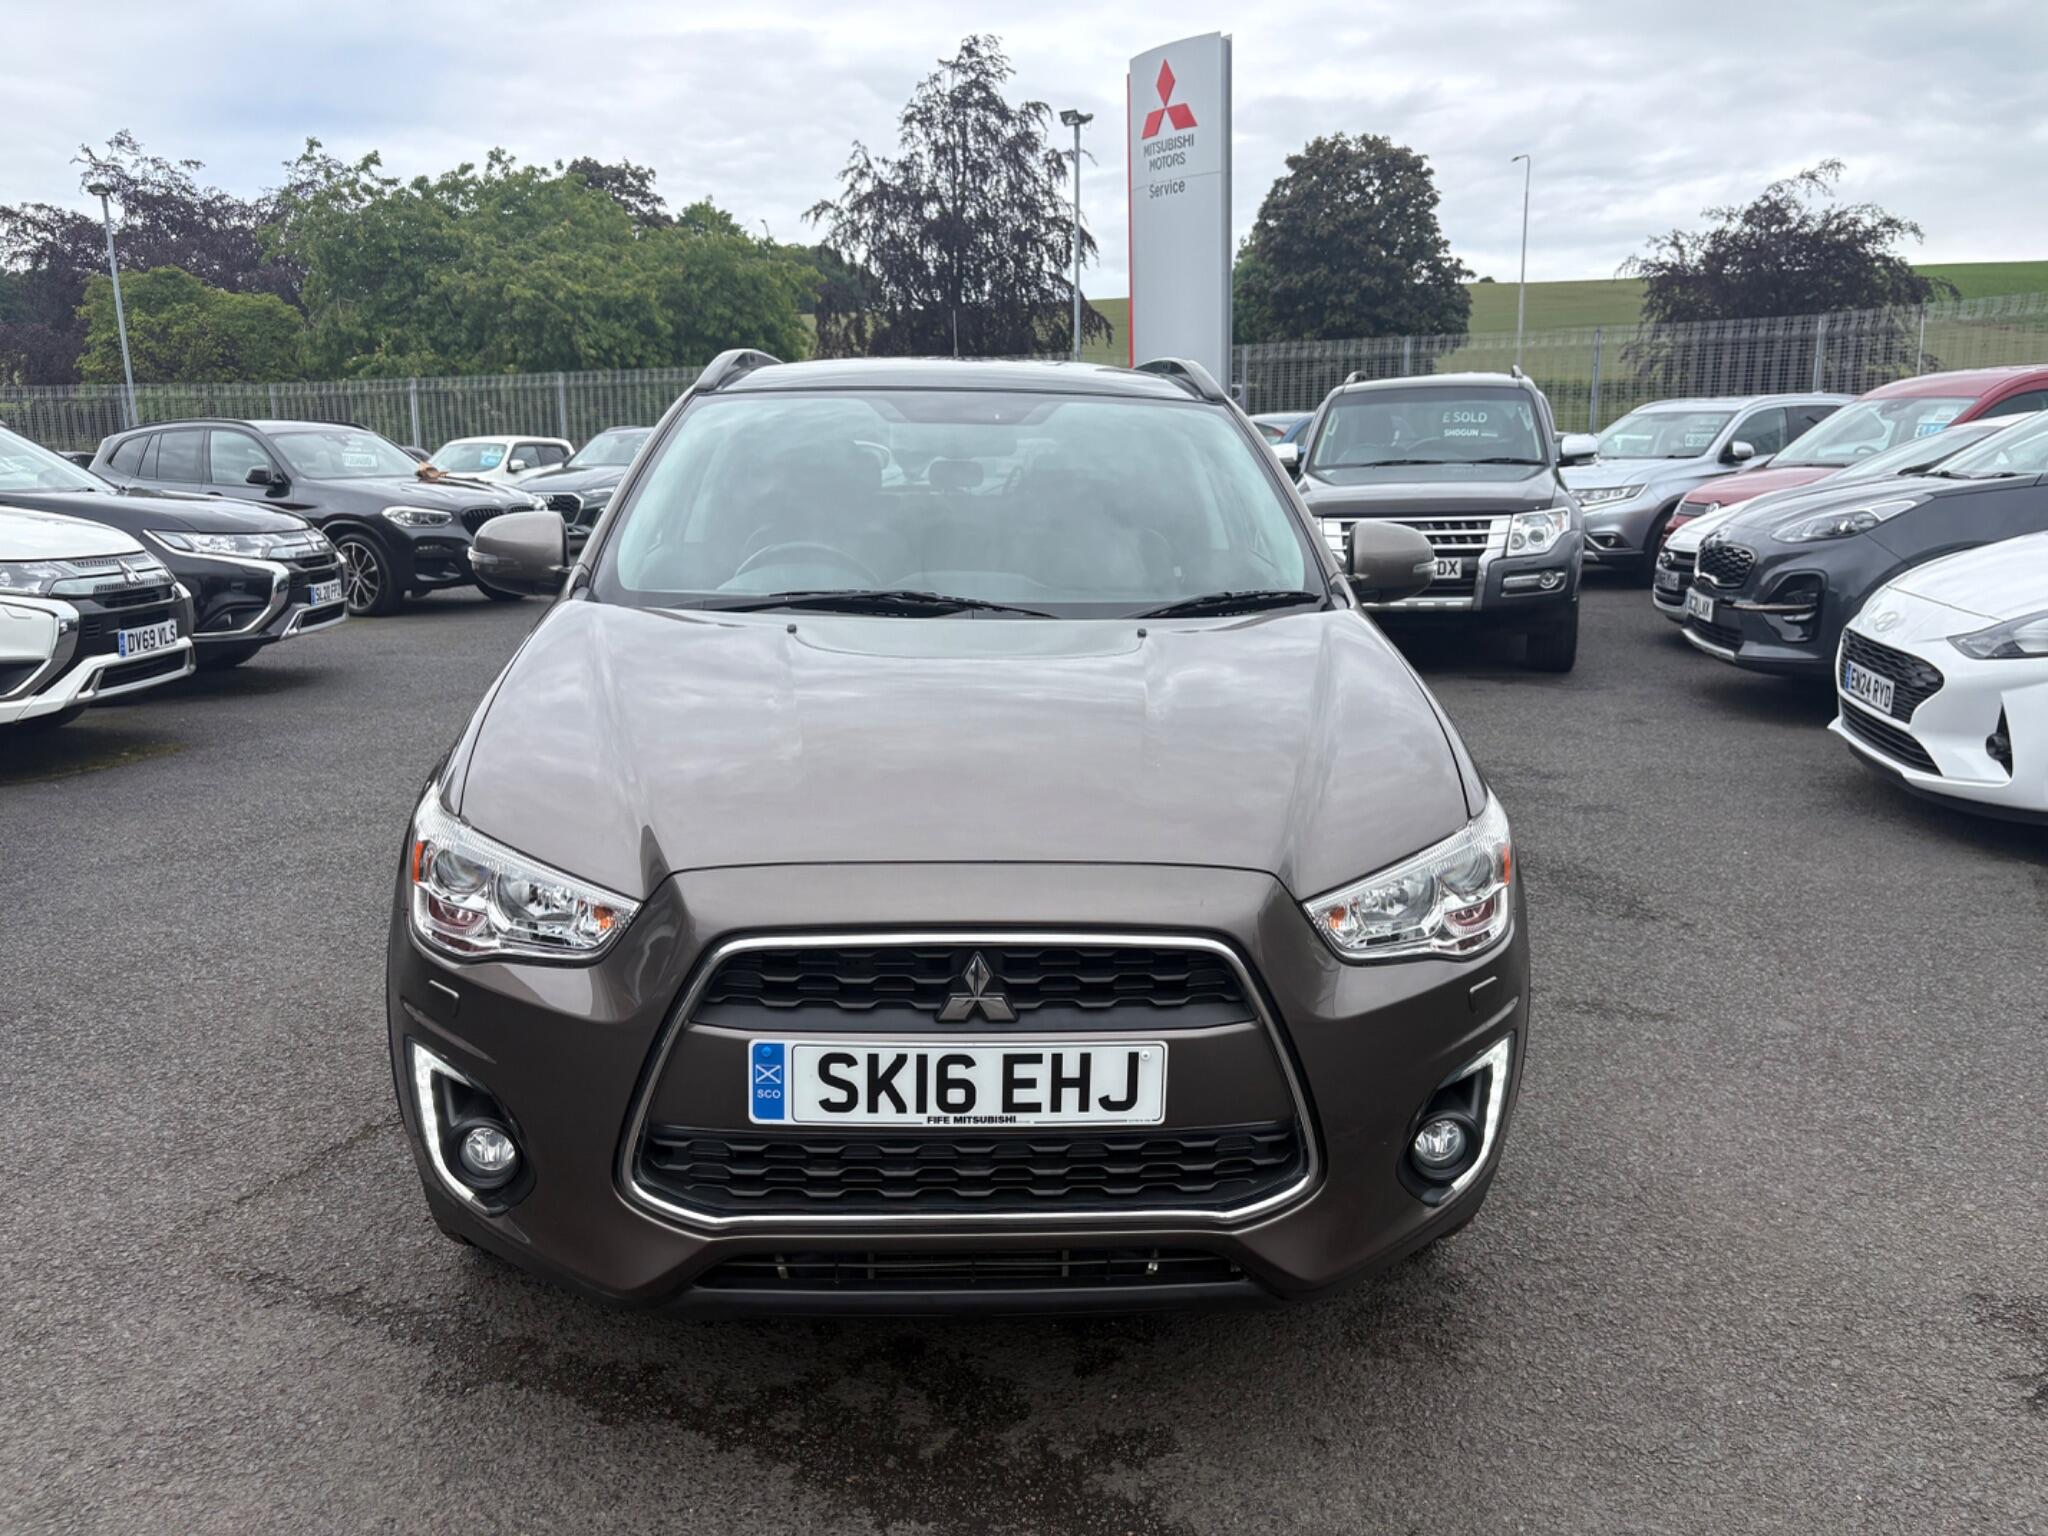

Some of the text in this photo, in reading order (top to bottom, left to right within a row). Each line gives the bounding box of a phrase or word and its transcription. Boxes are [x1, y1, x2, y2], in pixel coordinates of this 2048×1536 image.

[1143, 134, 1194, 158] MITSUBISHI
[1149, 151, 1186, 171] MOTORS
[1149, 179, 1185, 199] Service
[1453, 411, 1488, 423] SOLD
[1443, 428, 1479, 437] SHOGUN
[1437, 560, 1458, 575] DX
[128, 624, 176, 653] DV69 VLS
[1851, 668, 1891, 708] EN24 RYD
[818, 1052, 1139, 1114] SK16 EHJ
[757, 1089, 781, 1099] SCO
[927, 1116, 950, 1125] FIFE
[953, 1115, 1017, 1125] MITSUBISHI
